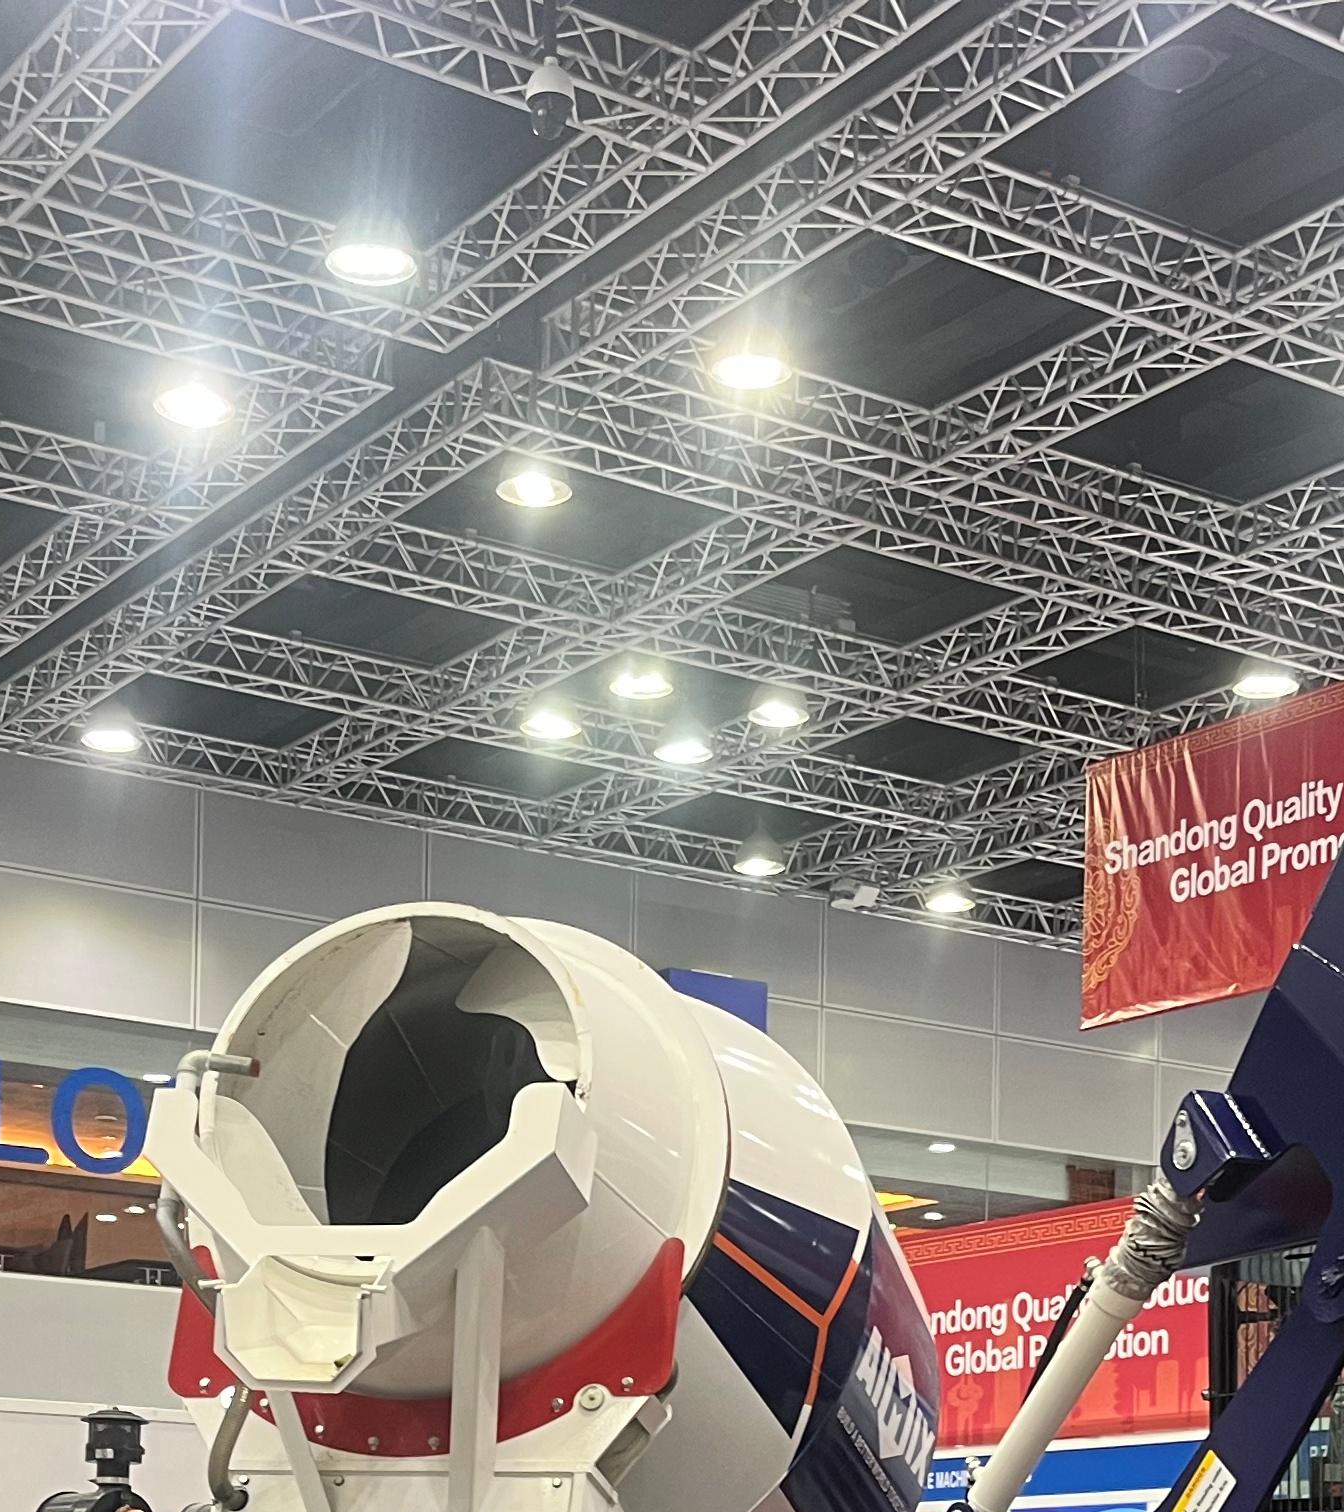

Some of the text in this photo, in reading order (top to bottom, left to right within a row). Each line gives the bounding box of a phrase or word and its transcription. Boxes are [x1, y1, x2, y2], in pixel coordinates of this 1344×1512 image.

[1105, 813, 1238, 874] Shandong
[1242, 780, 1344, 841] Quality
[1169, 847, 1255, 903] Global
[930, 1298, 1008, 1337] ndong
[944, 1335, 1024, 1376] Global
